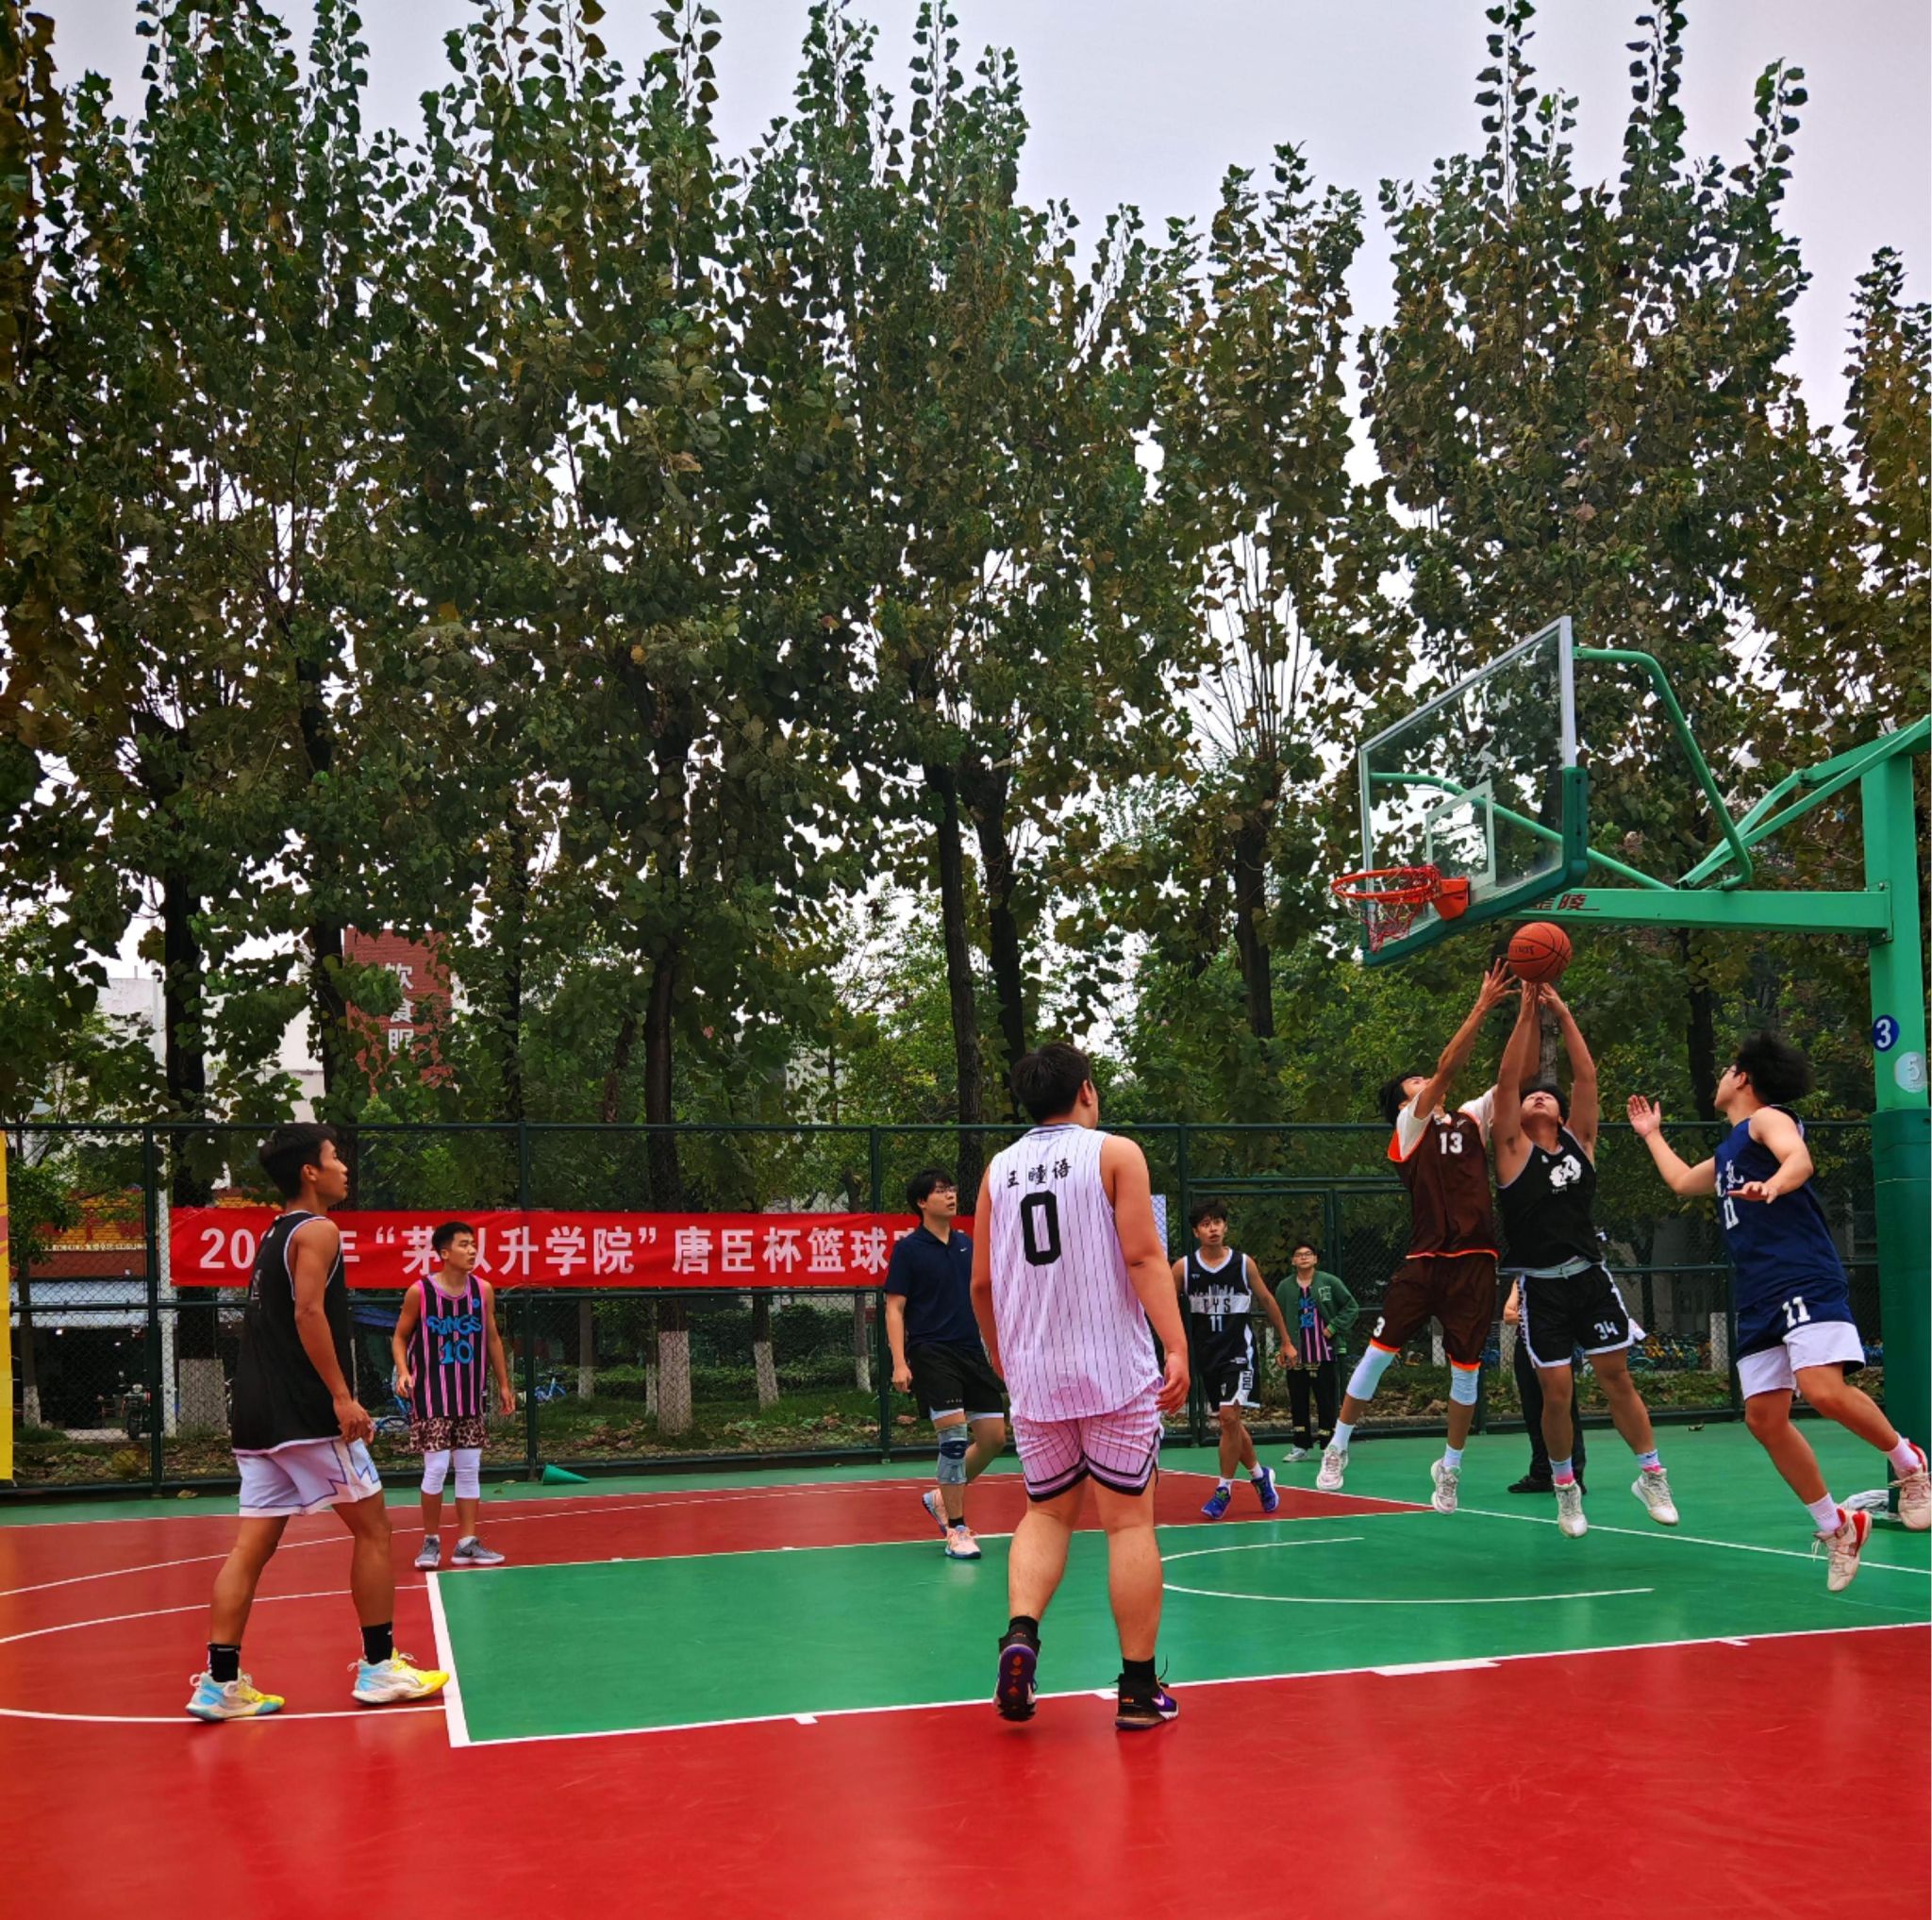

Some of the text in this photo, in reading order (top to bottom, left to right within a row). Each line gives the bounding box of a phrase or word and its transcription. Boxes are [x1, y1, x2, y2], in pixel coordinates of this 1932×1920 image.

[1876, 1019, 1891, 1048] 3
[1440, 1132, 1463, 1155] 13
[1020, 1190, 1061, 1266] 0
[1209, 1315, 1223, 1332] 11
[1782, 1296, 1811, 1328] 11
[1593, 1320, 1619, 1341] 34
[440, 1340, 474, 1364] 10
